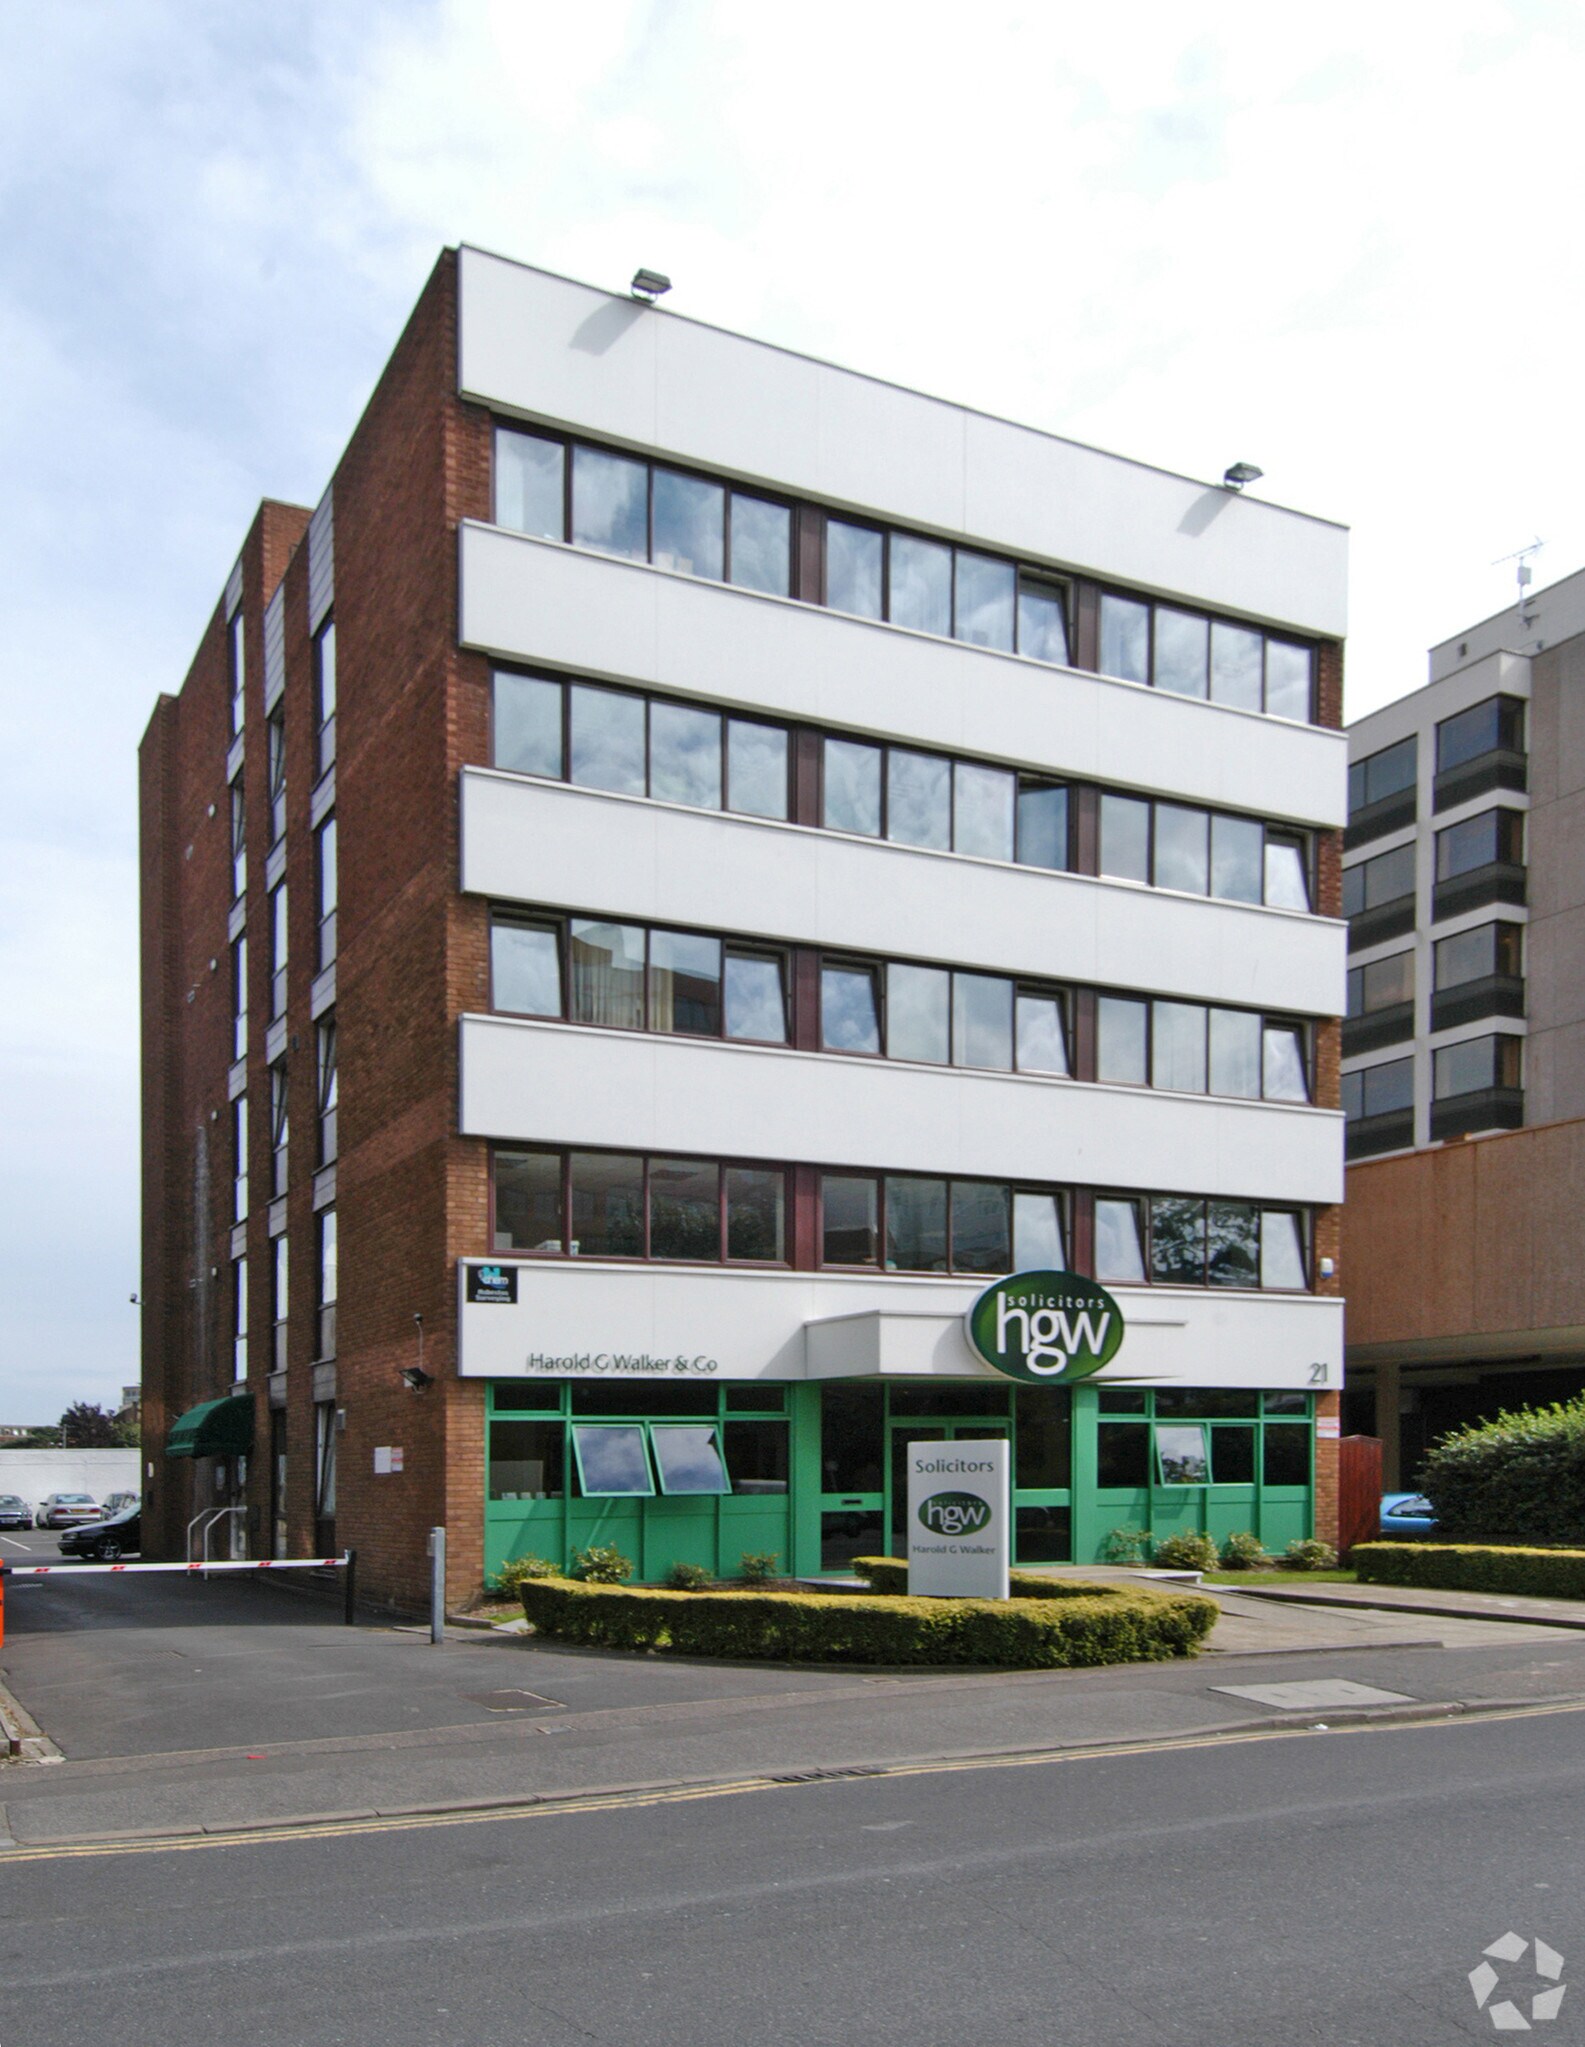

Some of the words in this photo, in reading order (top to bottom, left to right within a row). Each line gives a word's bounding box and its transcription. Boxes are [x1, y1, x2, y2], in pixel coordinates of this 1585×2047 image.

[1007, 1293, 1106, 1309] solicitors
[996, 1291, 1111, 1376] hgw
[529, 1352, 590, 1371] Harold
[613, 1353, 672, 1372] Walker
[675, 1355, 690, 1371] &
[693, 1355, 718, 1372] Co
[1310, 1362, 1328, 1383] 21
[915, 1459, 995, 1473] Solicitors
[927, 1499, 986, 1535] hgw
[913, 1544, 947, 1554] Harold
[949, 1545, 957, 1554] G
[959, 1545, 996, 1555] Walker
